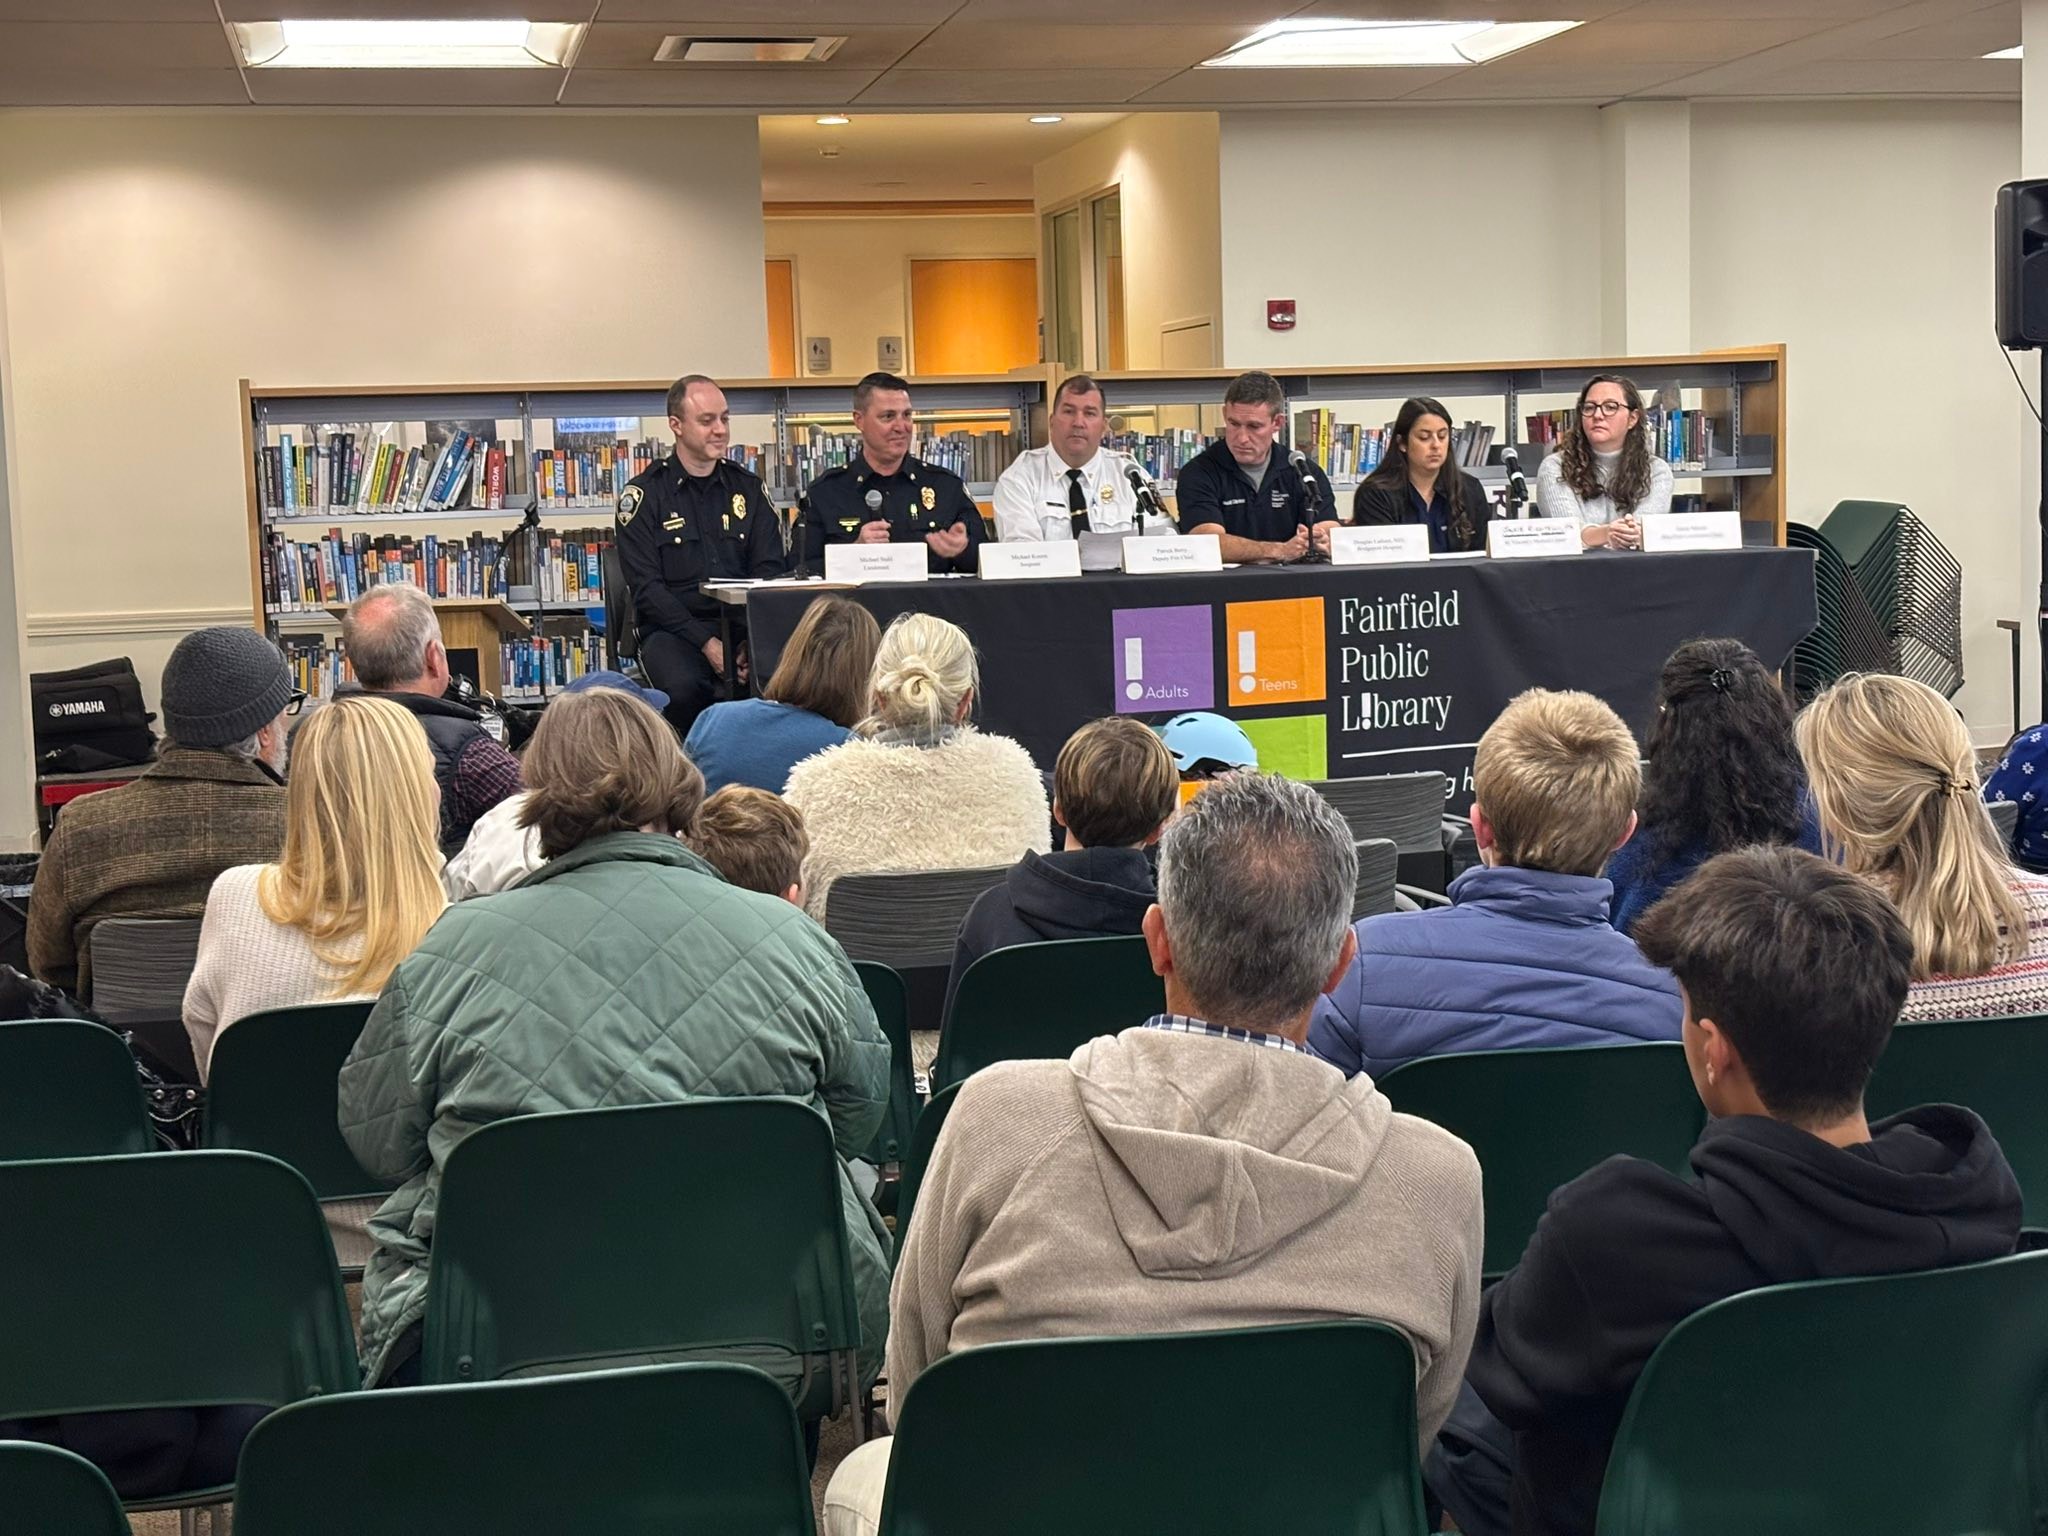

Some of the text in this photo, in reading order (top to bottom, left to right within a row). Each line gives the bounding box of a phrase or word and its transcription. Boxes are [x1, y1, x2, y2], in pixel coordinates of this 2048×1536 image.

[492, 466, 500, 499] WORLD
[587, 555, 599, 576] ITALY
[567, 565, 577, 591] ITALY
[1339, 590, 1460, 635] Fairfield
[1341, 642, 1429, 683] Public
[1146, 684, 1189, 699] Adults
[1259, 678, 1298, 692] Teens
[62, 700, 106, 715] YAMAHA
